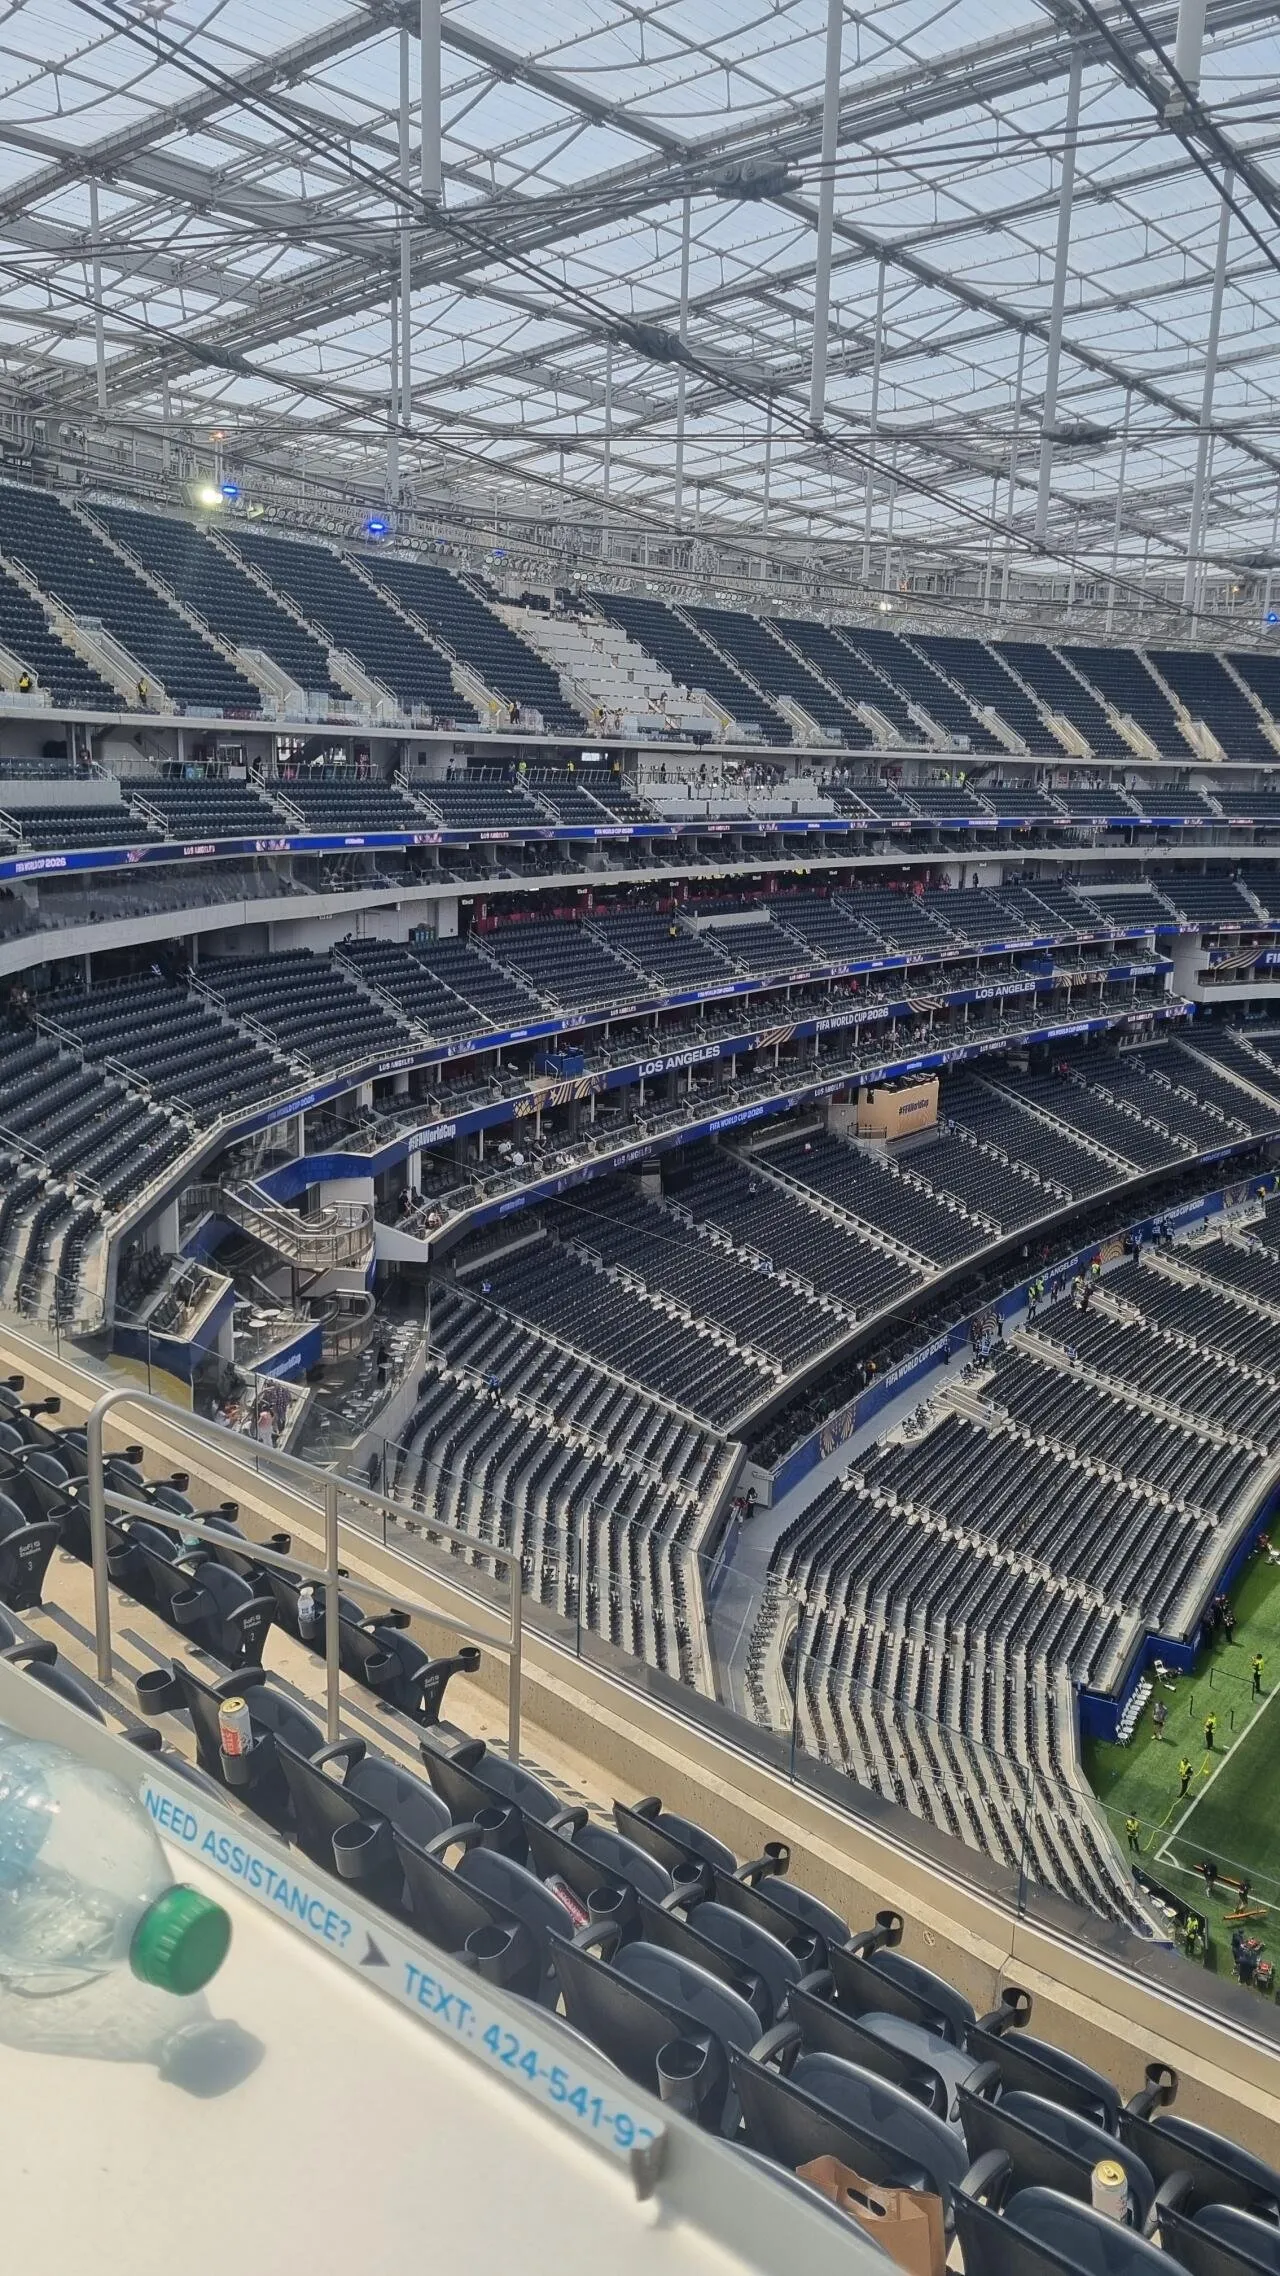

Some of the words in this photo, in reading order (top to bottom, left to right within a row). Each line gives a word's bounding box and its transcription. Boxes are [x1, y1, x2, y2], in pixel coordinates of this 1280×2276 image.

[45, 858, 67, 868] 2026
[975, 988, 994, 999] LOS
[995, 982, 1035, 996] ANGELES
[816, 1019, 830, 1032] FIFA
[831, 1014, 853, 1028] WORLD
[854, 1011, 867, 1023] CUP
[867, 1007, 888, 1020] 2026
[639, 1060, 663, 1077] LOS
[666, 1045, 720, 1069] ANGELES
[710, 1120, 720, 1131] FIFA
[721, 1115, 737, 1127] WORLD
[738, 1111, 748, 1122] CUP
[614, 1155, 625, 1167] LOS
[1050, 1257, 1079, 1277] ANGELES
[885, 1371, 898, 1388] FIFA
[898, 1357, 918, 1378] WORLD
[918, 1348, 929, 1364] CUP
[19, 1543, 33, 1552] SoFi
[28, 1561, 33, 1571] 3
[250, 1633, 255, 1641] 2
[145, 1789, 197, 1842] NEED
[200, 1830, 352, 1947] ASSISTANCE?
[404, 1963, 476, 2038] TEXT:
